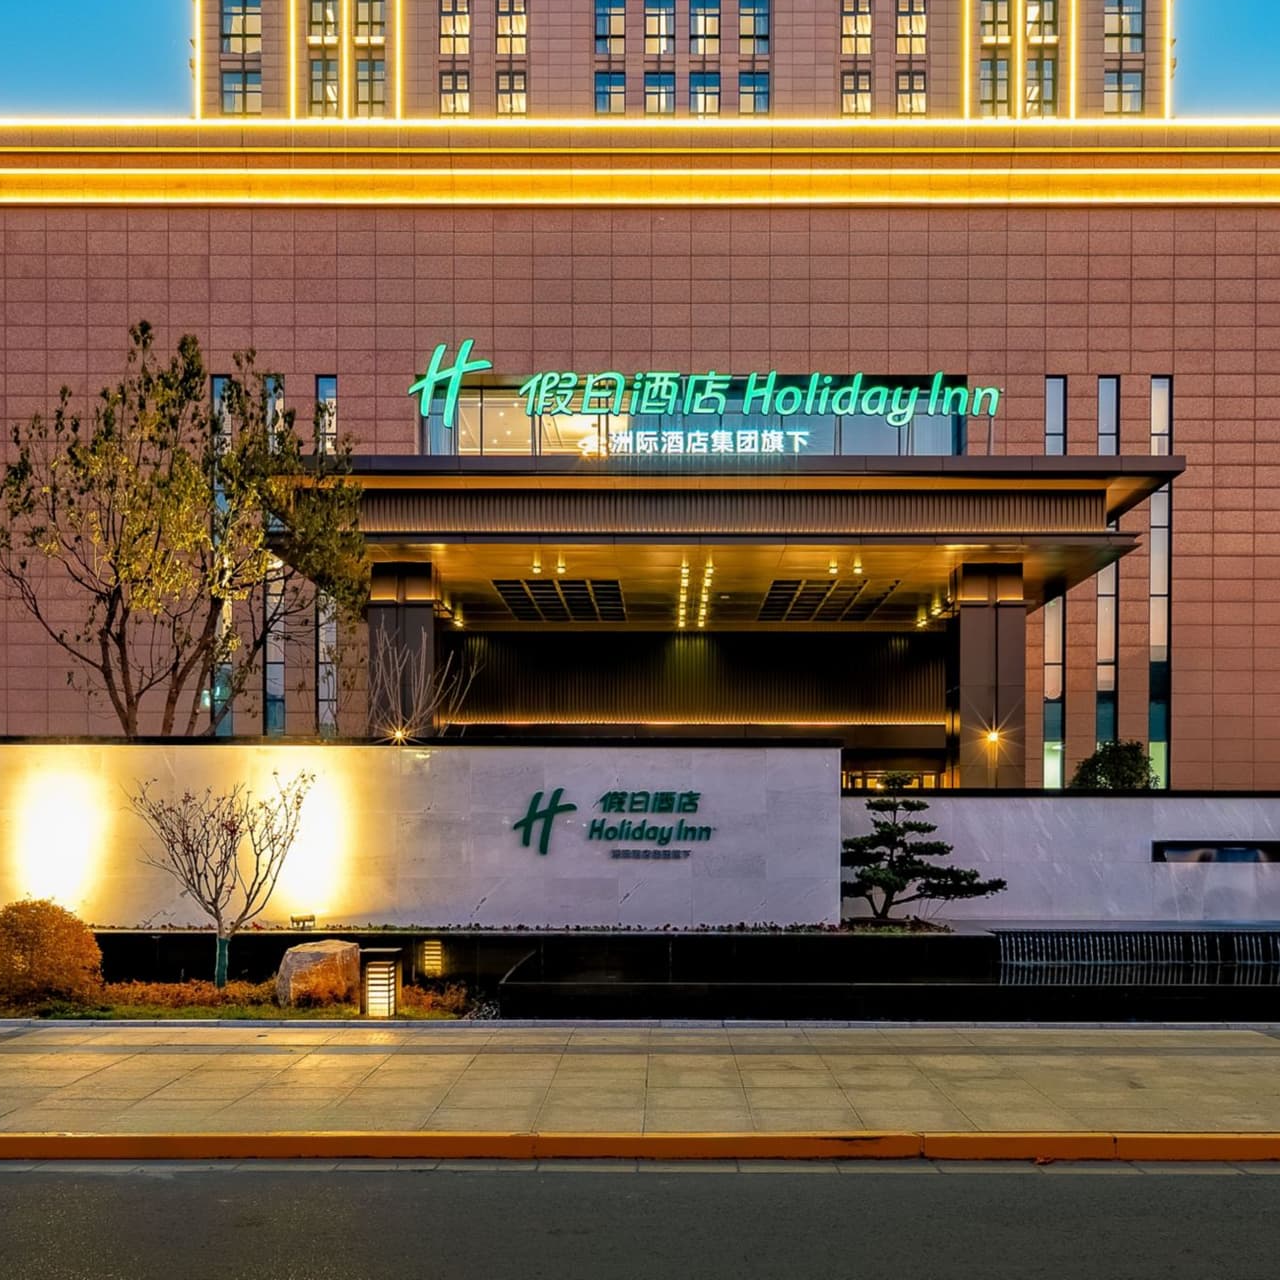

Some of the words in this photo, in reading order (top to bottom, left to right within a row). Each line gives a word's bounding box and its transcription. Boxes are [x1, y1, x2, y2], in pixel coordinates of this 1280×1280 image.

[519, 370, 732, 418] 假日酒店
[742, 371, 921, 427] Holiday
[927, 371, 1000, 418] Inn
[610, 430, 810, 455] 洲际酒店集团旗下
[592, 790, 701, 814] 假日酒店
[588, 818, 675, 846] Holiday
[677, 818, 713, 842] Inn
